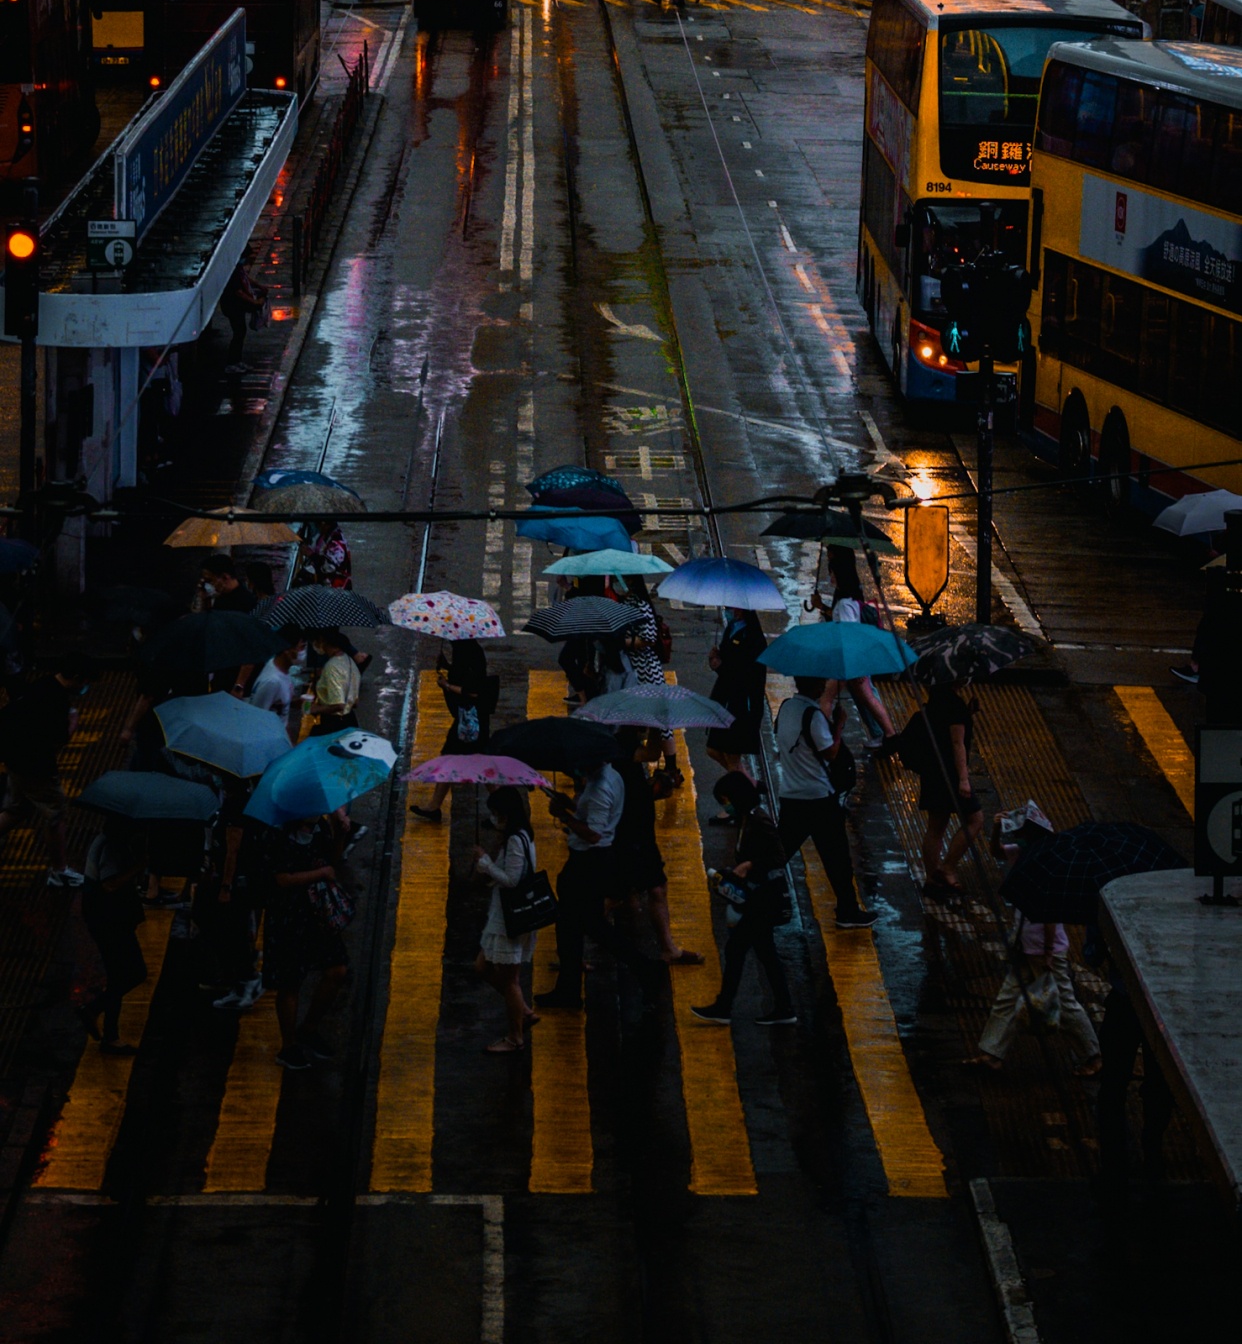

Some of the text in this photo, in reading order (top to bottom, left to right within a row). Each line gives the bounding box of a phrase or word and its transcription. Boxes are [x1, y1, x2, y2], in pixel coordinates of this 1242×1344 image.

[978, 140, 1032, 161] 銅鑼
[973, 157, 1027, 174] Causeway
[926, 181, 952, 192] 8194
